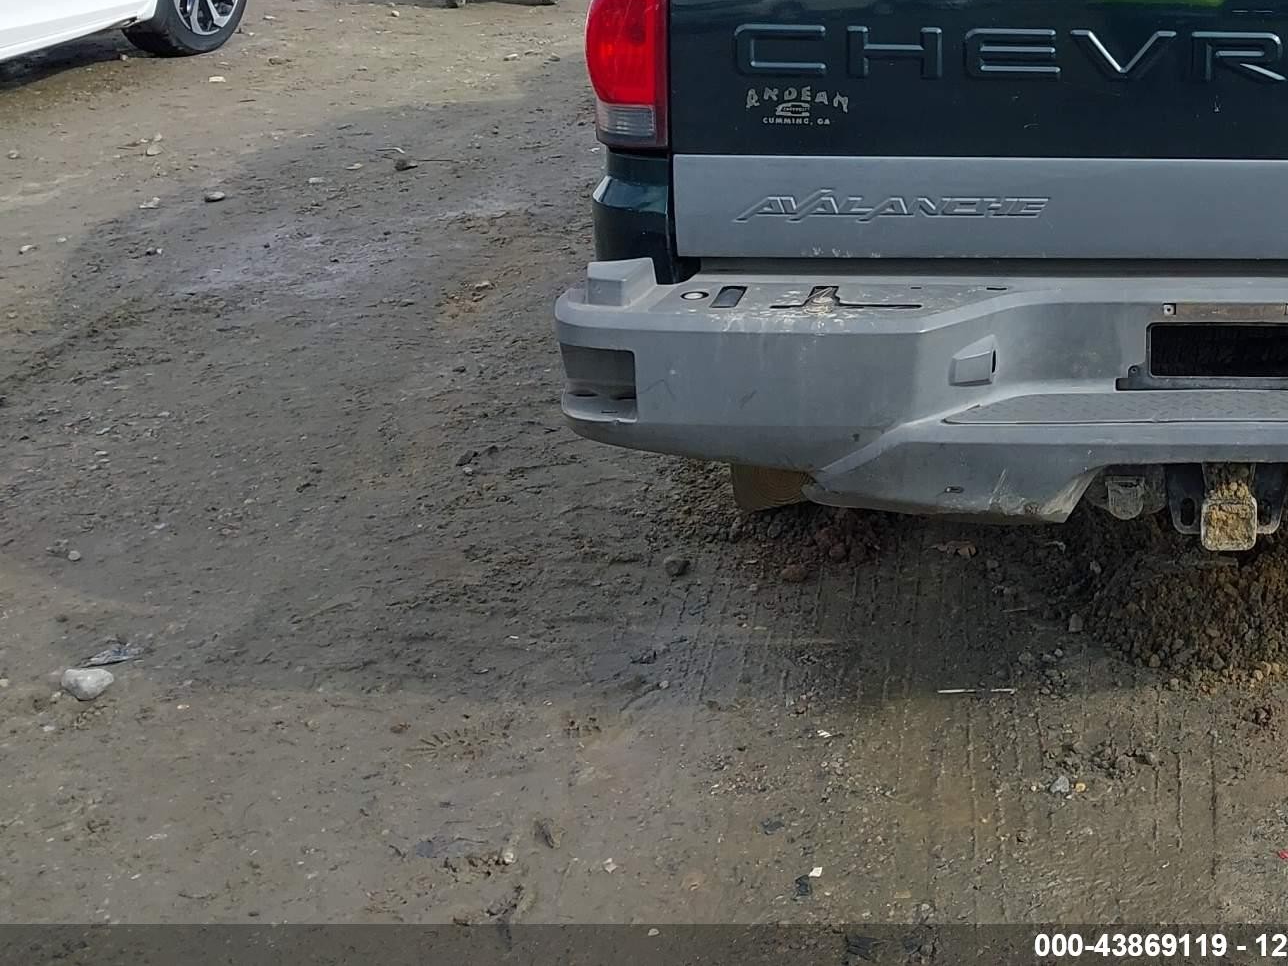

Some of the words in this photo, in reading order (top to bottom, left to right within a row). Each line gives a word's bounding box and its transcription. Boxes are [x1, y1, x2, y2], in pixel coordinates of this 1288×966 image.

[745, 85, 849, 114] ANDEAN
[816, 117, 831, 125] GA
[731, 187, 1051, 224] AVALANCHE
